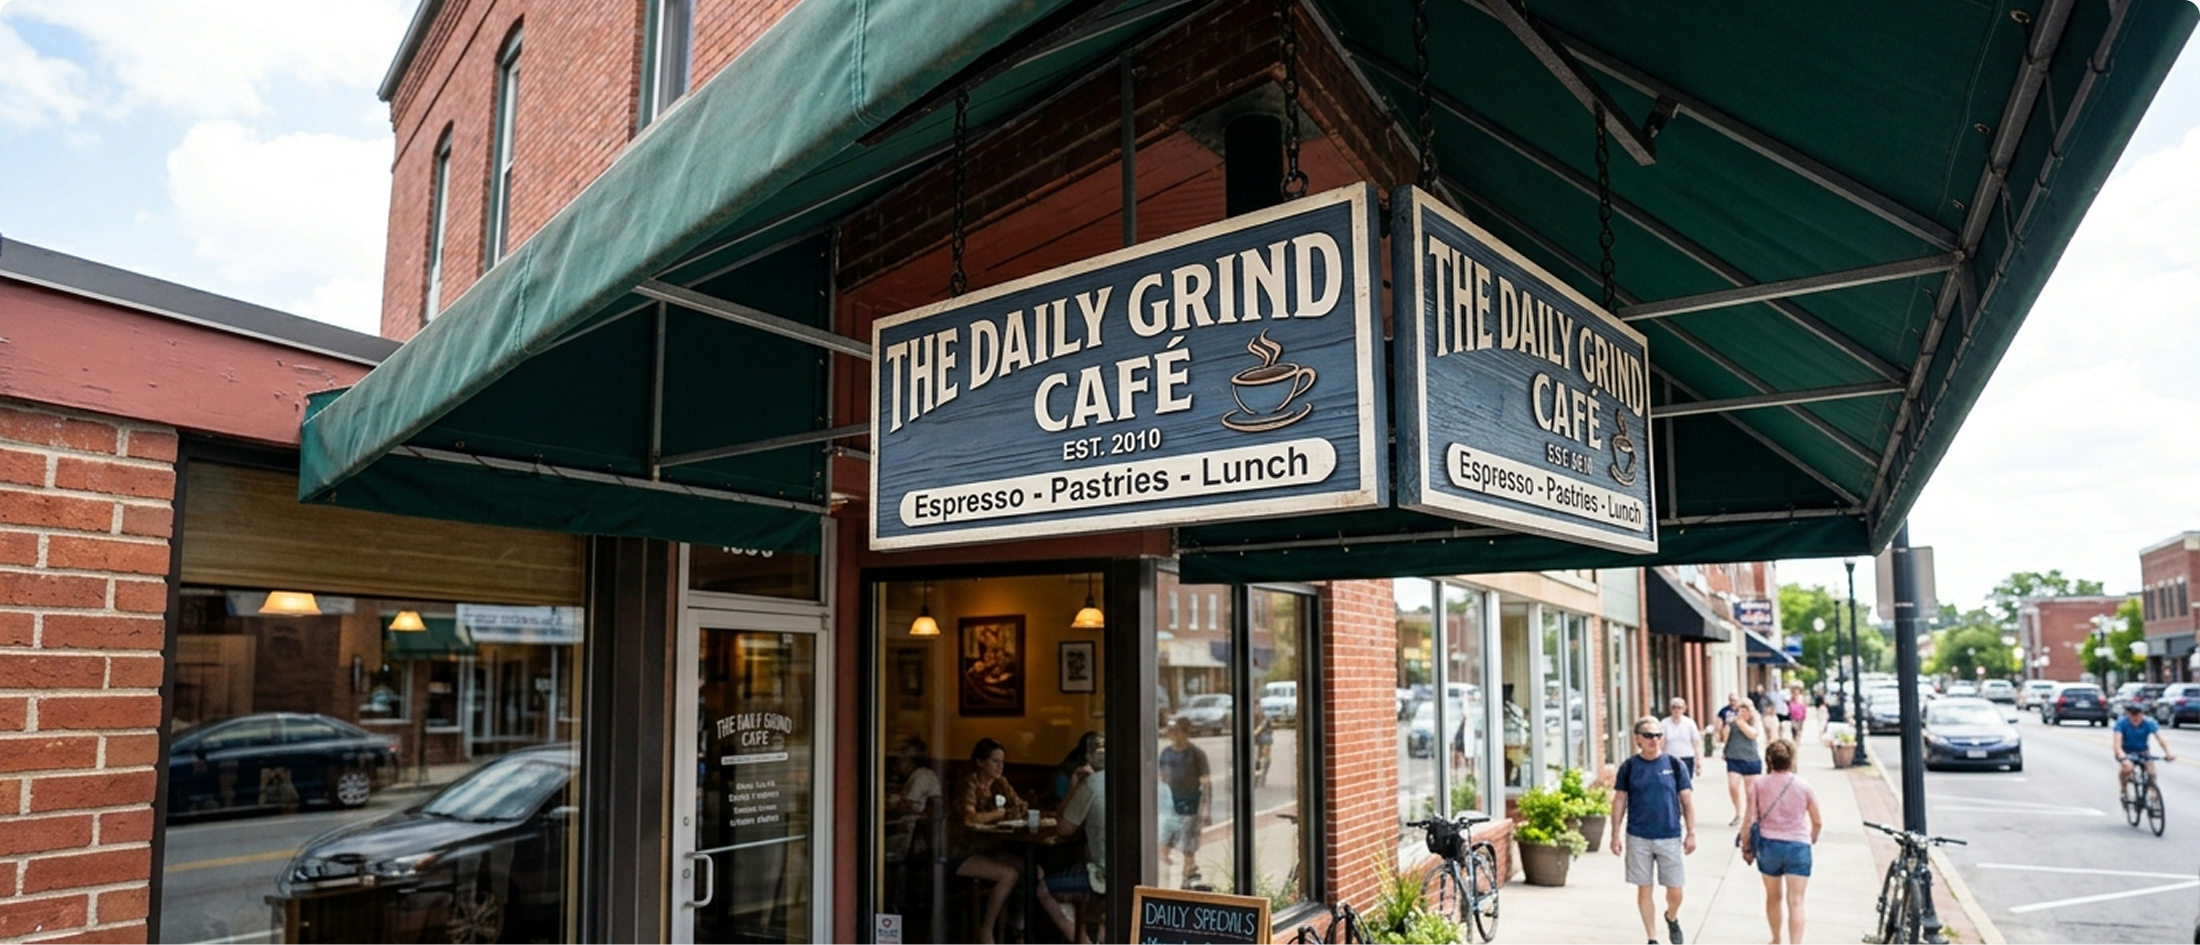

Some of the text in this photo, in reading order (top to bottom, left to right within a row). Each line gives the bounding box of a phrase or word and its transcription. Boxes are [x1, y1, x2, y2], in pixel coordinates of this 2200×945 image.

[886, 231, 1343, 435] THE DAILY GRIND
[1429, 235, 1645, 418] THE DAILY GRIND
[1034, 336, 1193, 432] CAFÉ
[1533, 372, 1602, 450] CAFÉ
[1063, 428, 1161, 462] EST. 2010
[914, 485, 1025, 522] Espresso
[1052, 467, 1169, 504] Pastries
[1203, 447, 1308, 486] Lunch
[1460, 451, 1534, 495] Espresso
[1547, 476, 1598, 513] Pastries
[1608, 494, 1641, 524] Lunch
[717, 715, 735, 740] THE
[1145, 902, 1190, 929] DAILY
